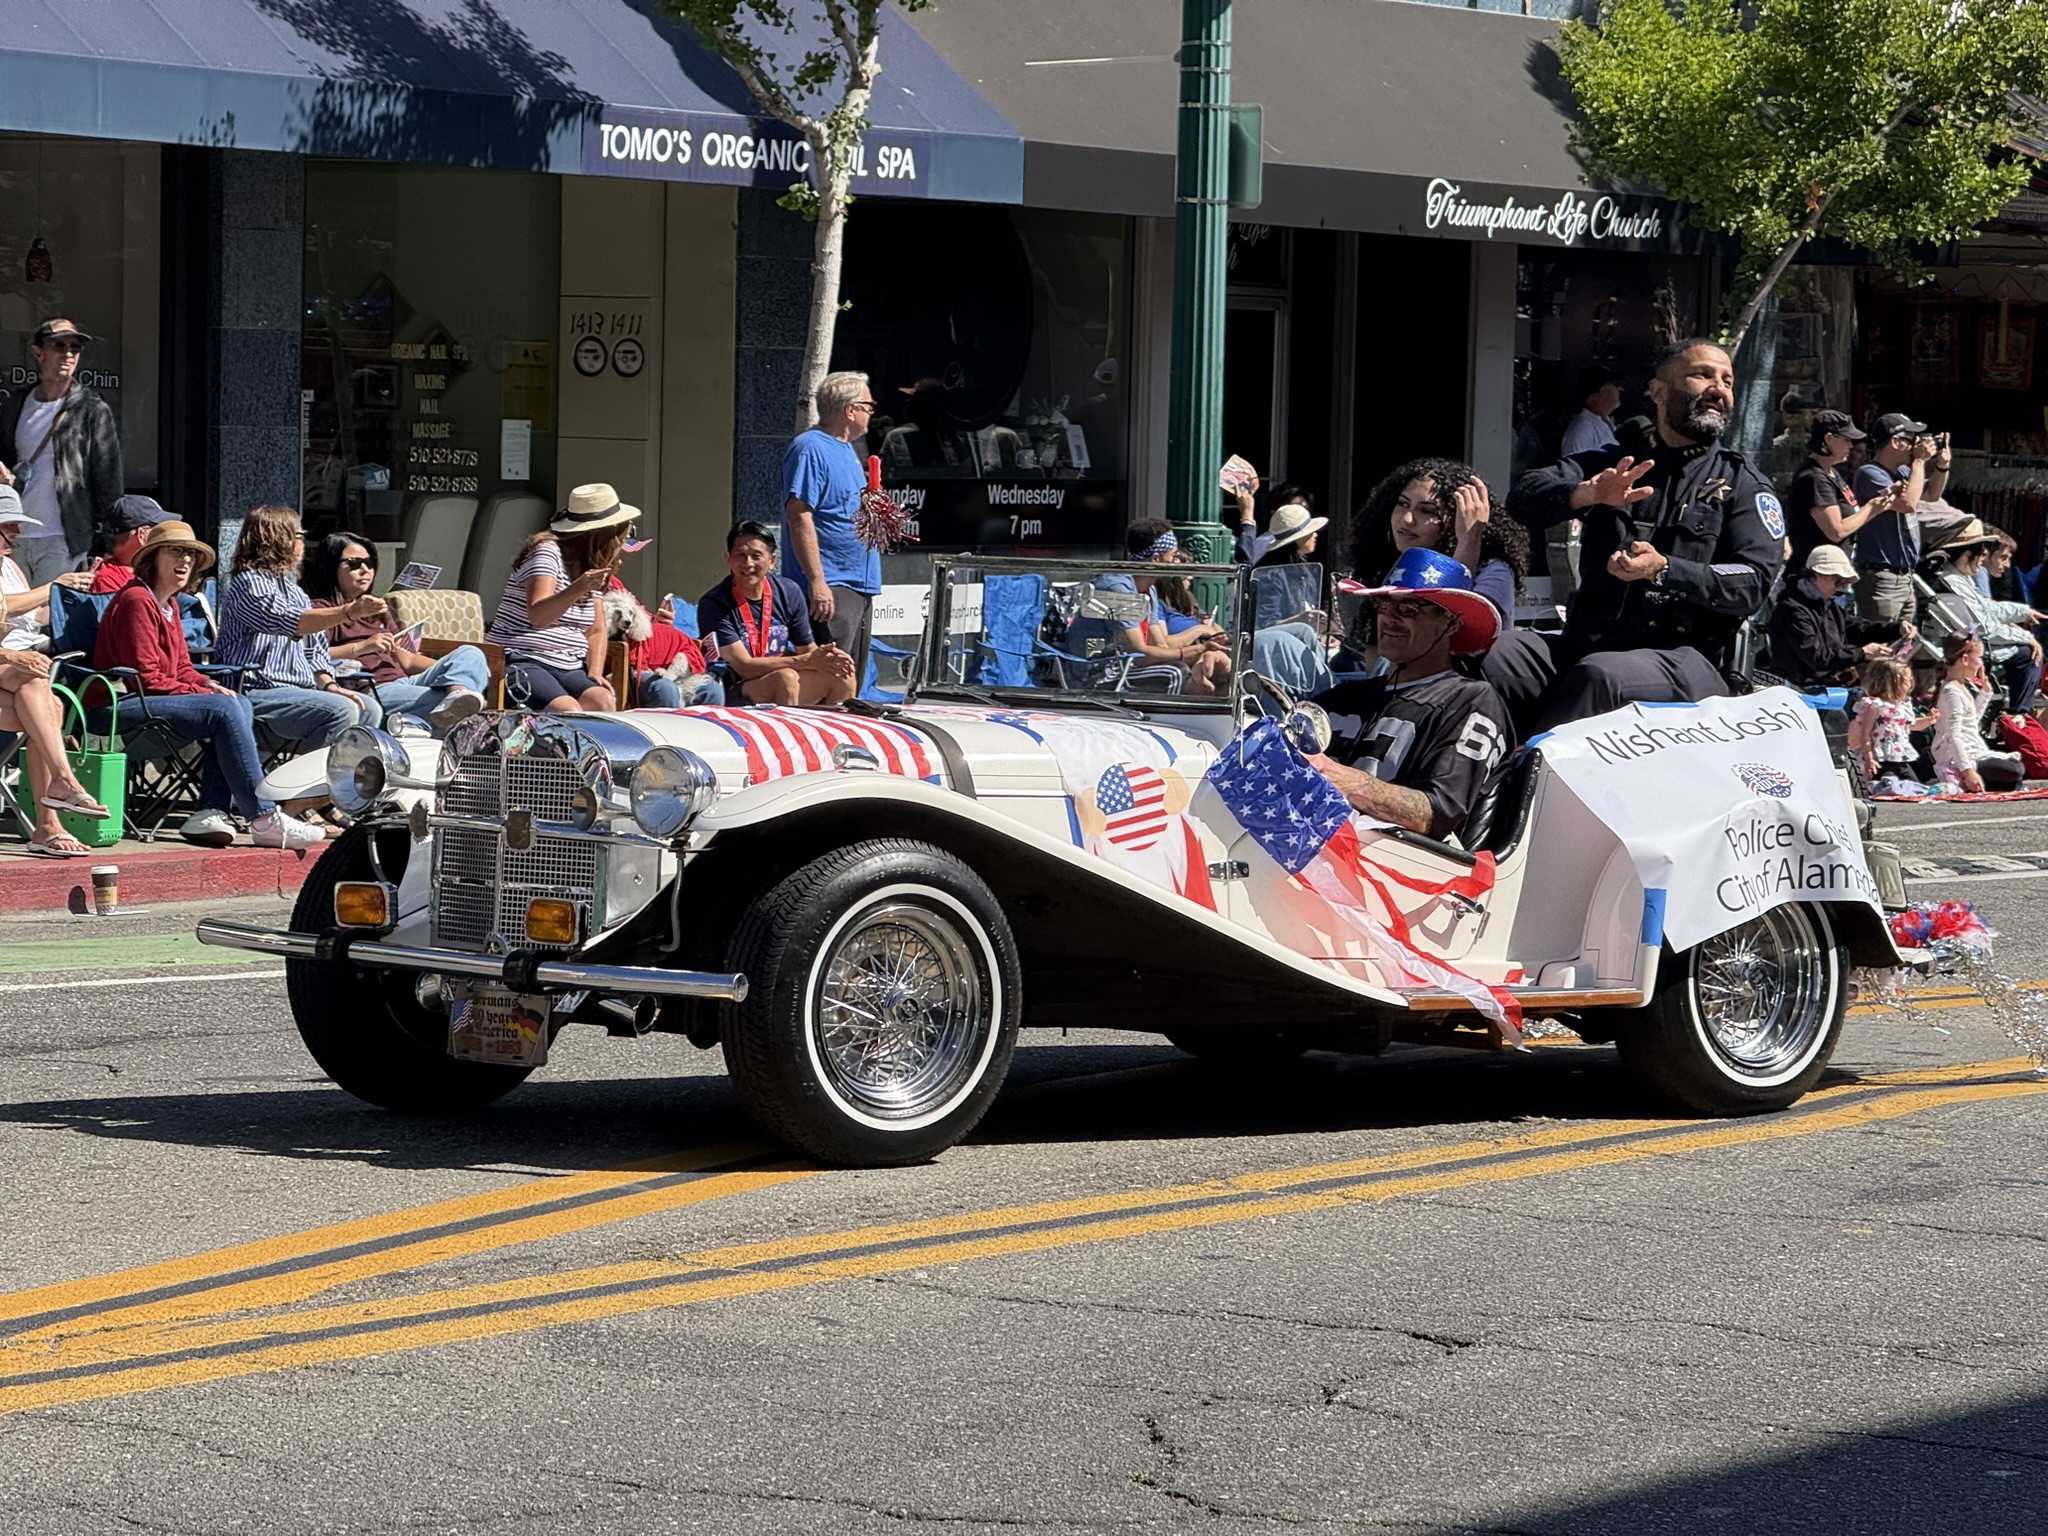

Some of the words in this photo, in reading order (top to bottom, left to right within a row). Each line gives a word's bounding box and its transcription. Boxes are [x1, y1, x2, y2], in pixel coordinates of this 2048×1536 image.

[600, 123, 692, 164] TOMO'S
[702, 132, 810, 173] ORGANIC
[877, 145, 916, 179] SPA
[1426, 178, 1549, 238] Triumphant
[1547, 192, 1588, 245] Life
[1590, 196, 1663, 239] Church
[570, 312, 604, 335] 1413
[610, 314, 642, 335] 1411
[391, 343, 426, 359] ORGANIC
[430, 344, 448, 359] NAIL
[79, 370, 119, 388] Chin
[414, 374, 446, 390] WAXING
[420, 399, 439, 414] NAIL
[412, 423, 450, 439] MASSAGE
[885, 484, 926, 510] unday
[988, 484, 1065, 509] Wednesday
[1010, 515, 1019, 535] 7
[1021, 518, 1042, 540] pm
[873, 605, 905, 620] online
[1585, 722, 1729, 765] Nishant
[1718, 702, 1809, 741] Joshi
[1724, 819, 1795, 862] Police
[1716, 873, 1762, 913] City
[1755, 859, 1771, 900] of
